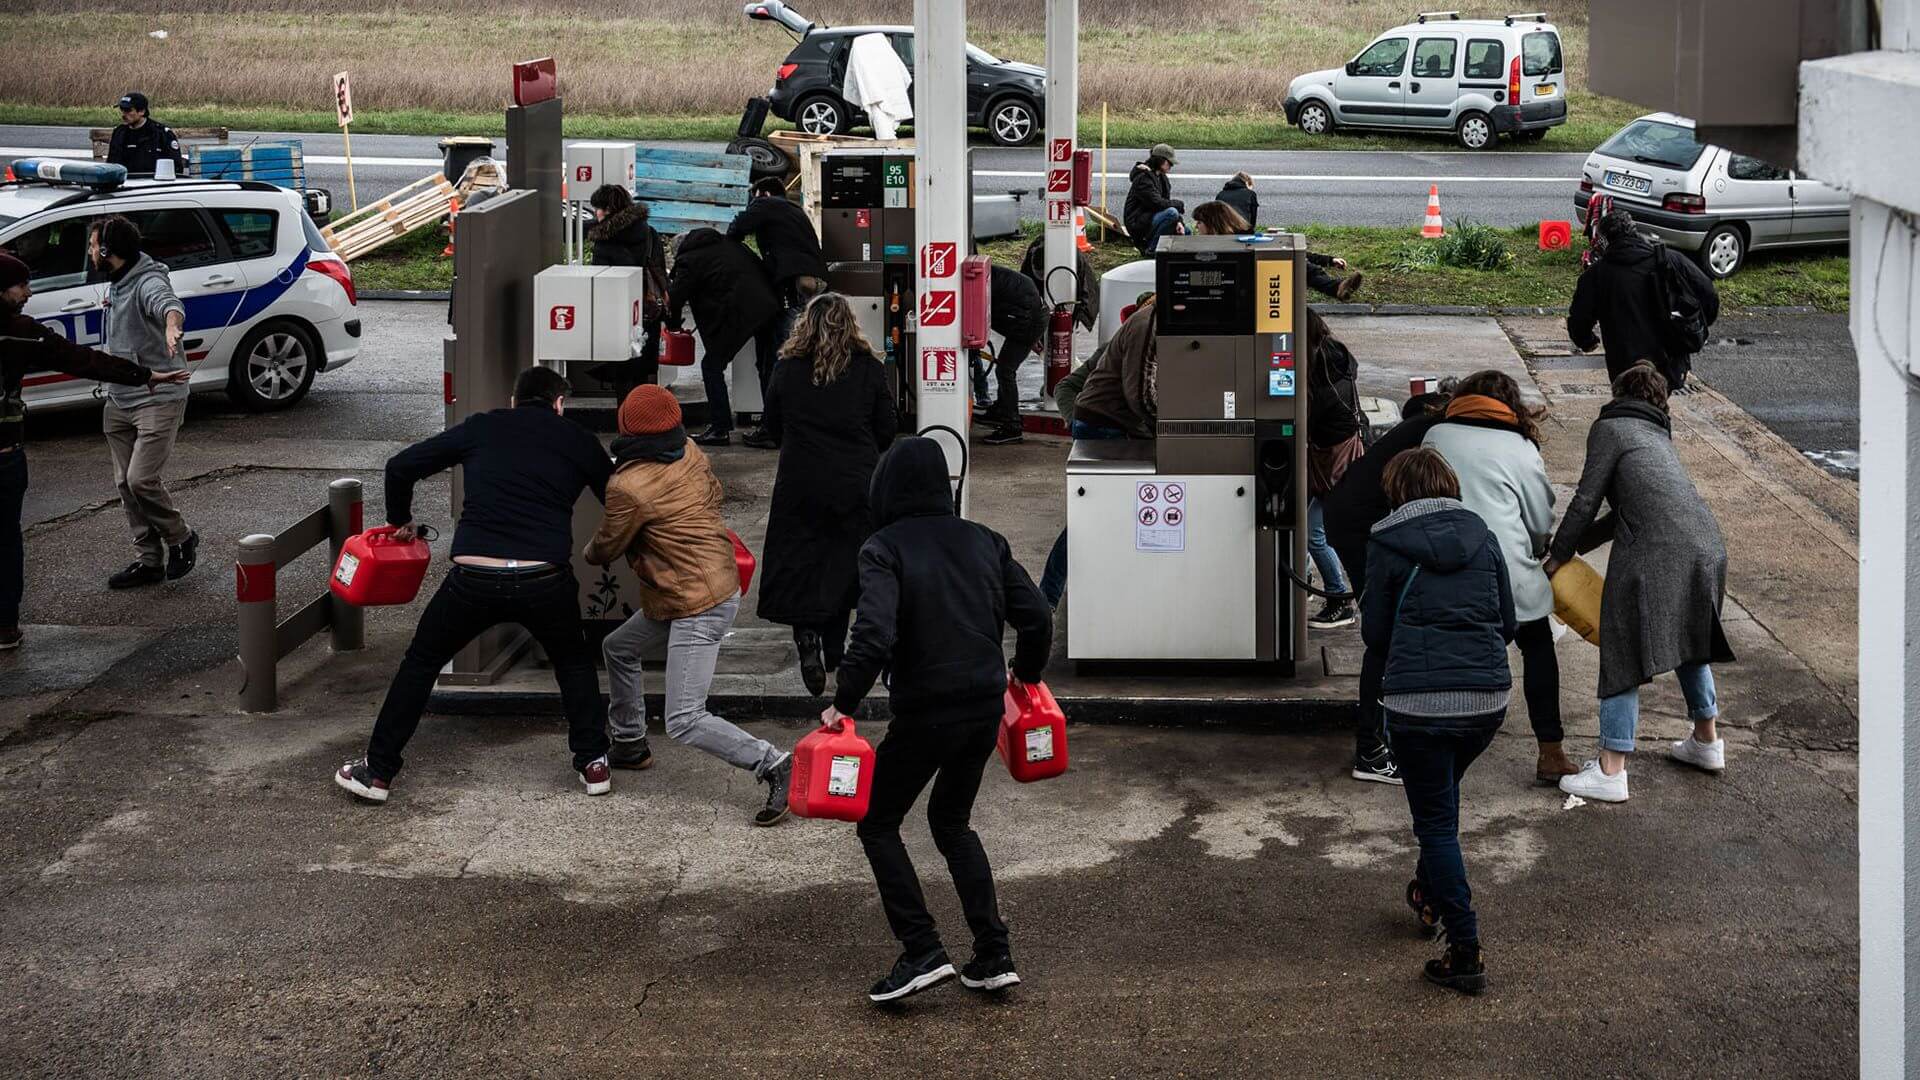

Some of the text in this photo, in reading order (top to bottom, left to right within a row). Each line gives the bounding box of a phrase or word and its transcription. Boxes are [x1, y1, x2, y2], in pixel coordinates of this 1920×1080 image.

[889, 165, 902, 175] 95
[886, 176, 905, 185] E10
[1269, 274, 1281, 319] DIESEL
[1279, 334, 1287, 351] 1
